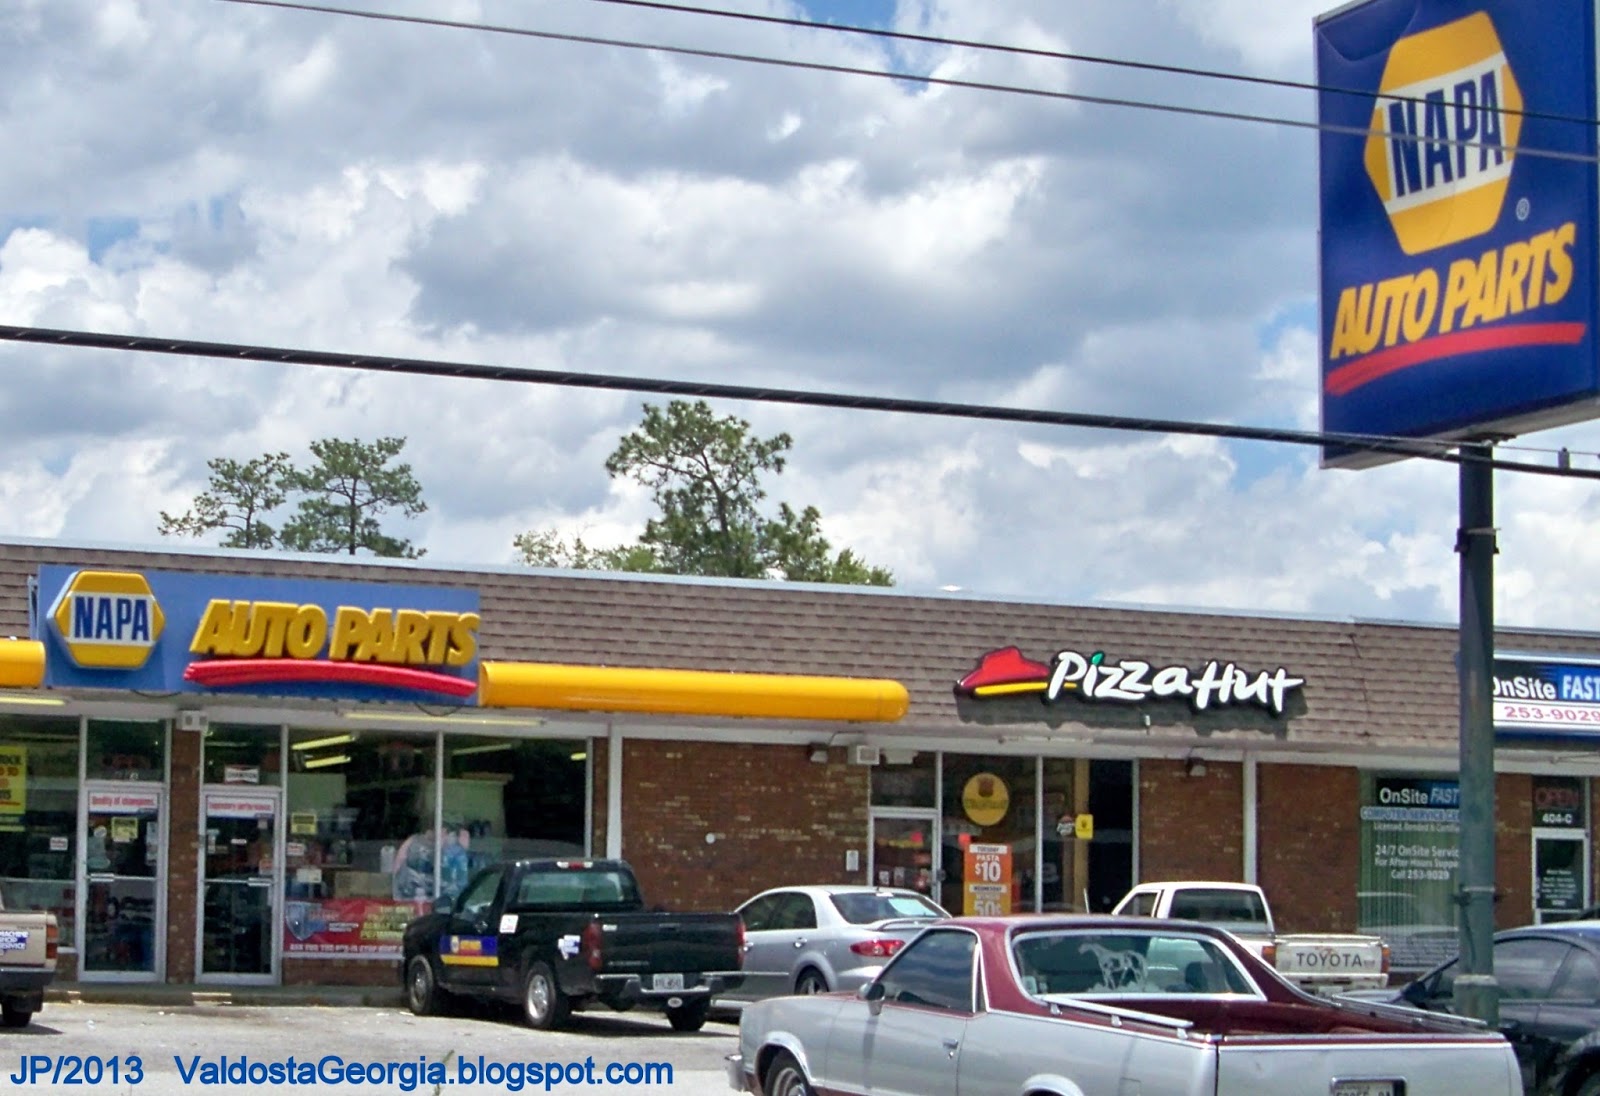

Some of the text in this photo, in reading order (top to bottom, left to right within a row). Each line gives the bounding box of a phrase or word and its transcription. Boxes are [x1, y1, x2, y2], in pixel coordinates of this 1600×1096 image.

[1388, 69, 1503, 197] NAPA
[1330, 222, 1576, 359] AUTO PARTS
[74, 595, 150, 641] NAPA
[189, 599, 481, 667] AUTO PARTS
[1048, 650, 1304, 713] Pizza Hut
[1504, 706, 1600, 722] 253-9029
[1380, 787, 1428, 804] OnSite
[976, 854, 1000, 862] PASTA
[1375, 845, 1396, 856] 24/7
[1398, 845, 1430, 857] OnSite
[975, 861, 1001, 882] $10
[1391, 869, 1450, 880] Call 253-9029
[1296, 952, 1363, 968] TOYOTA
